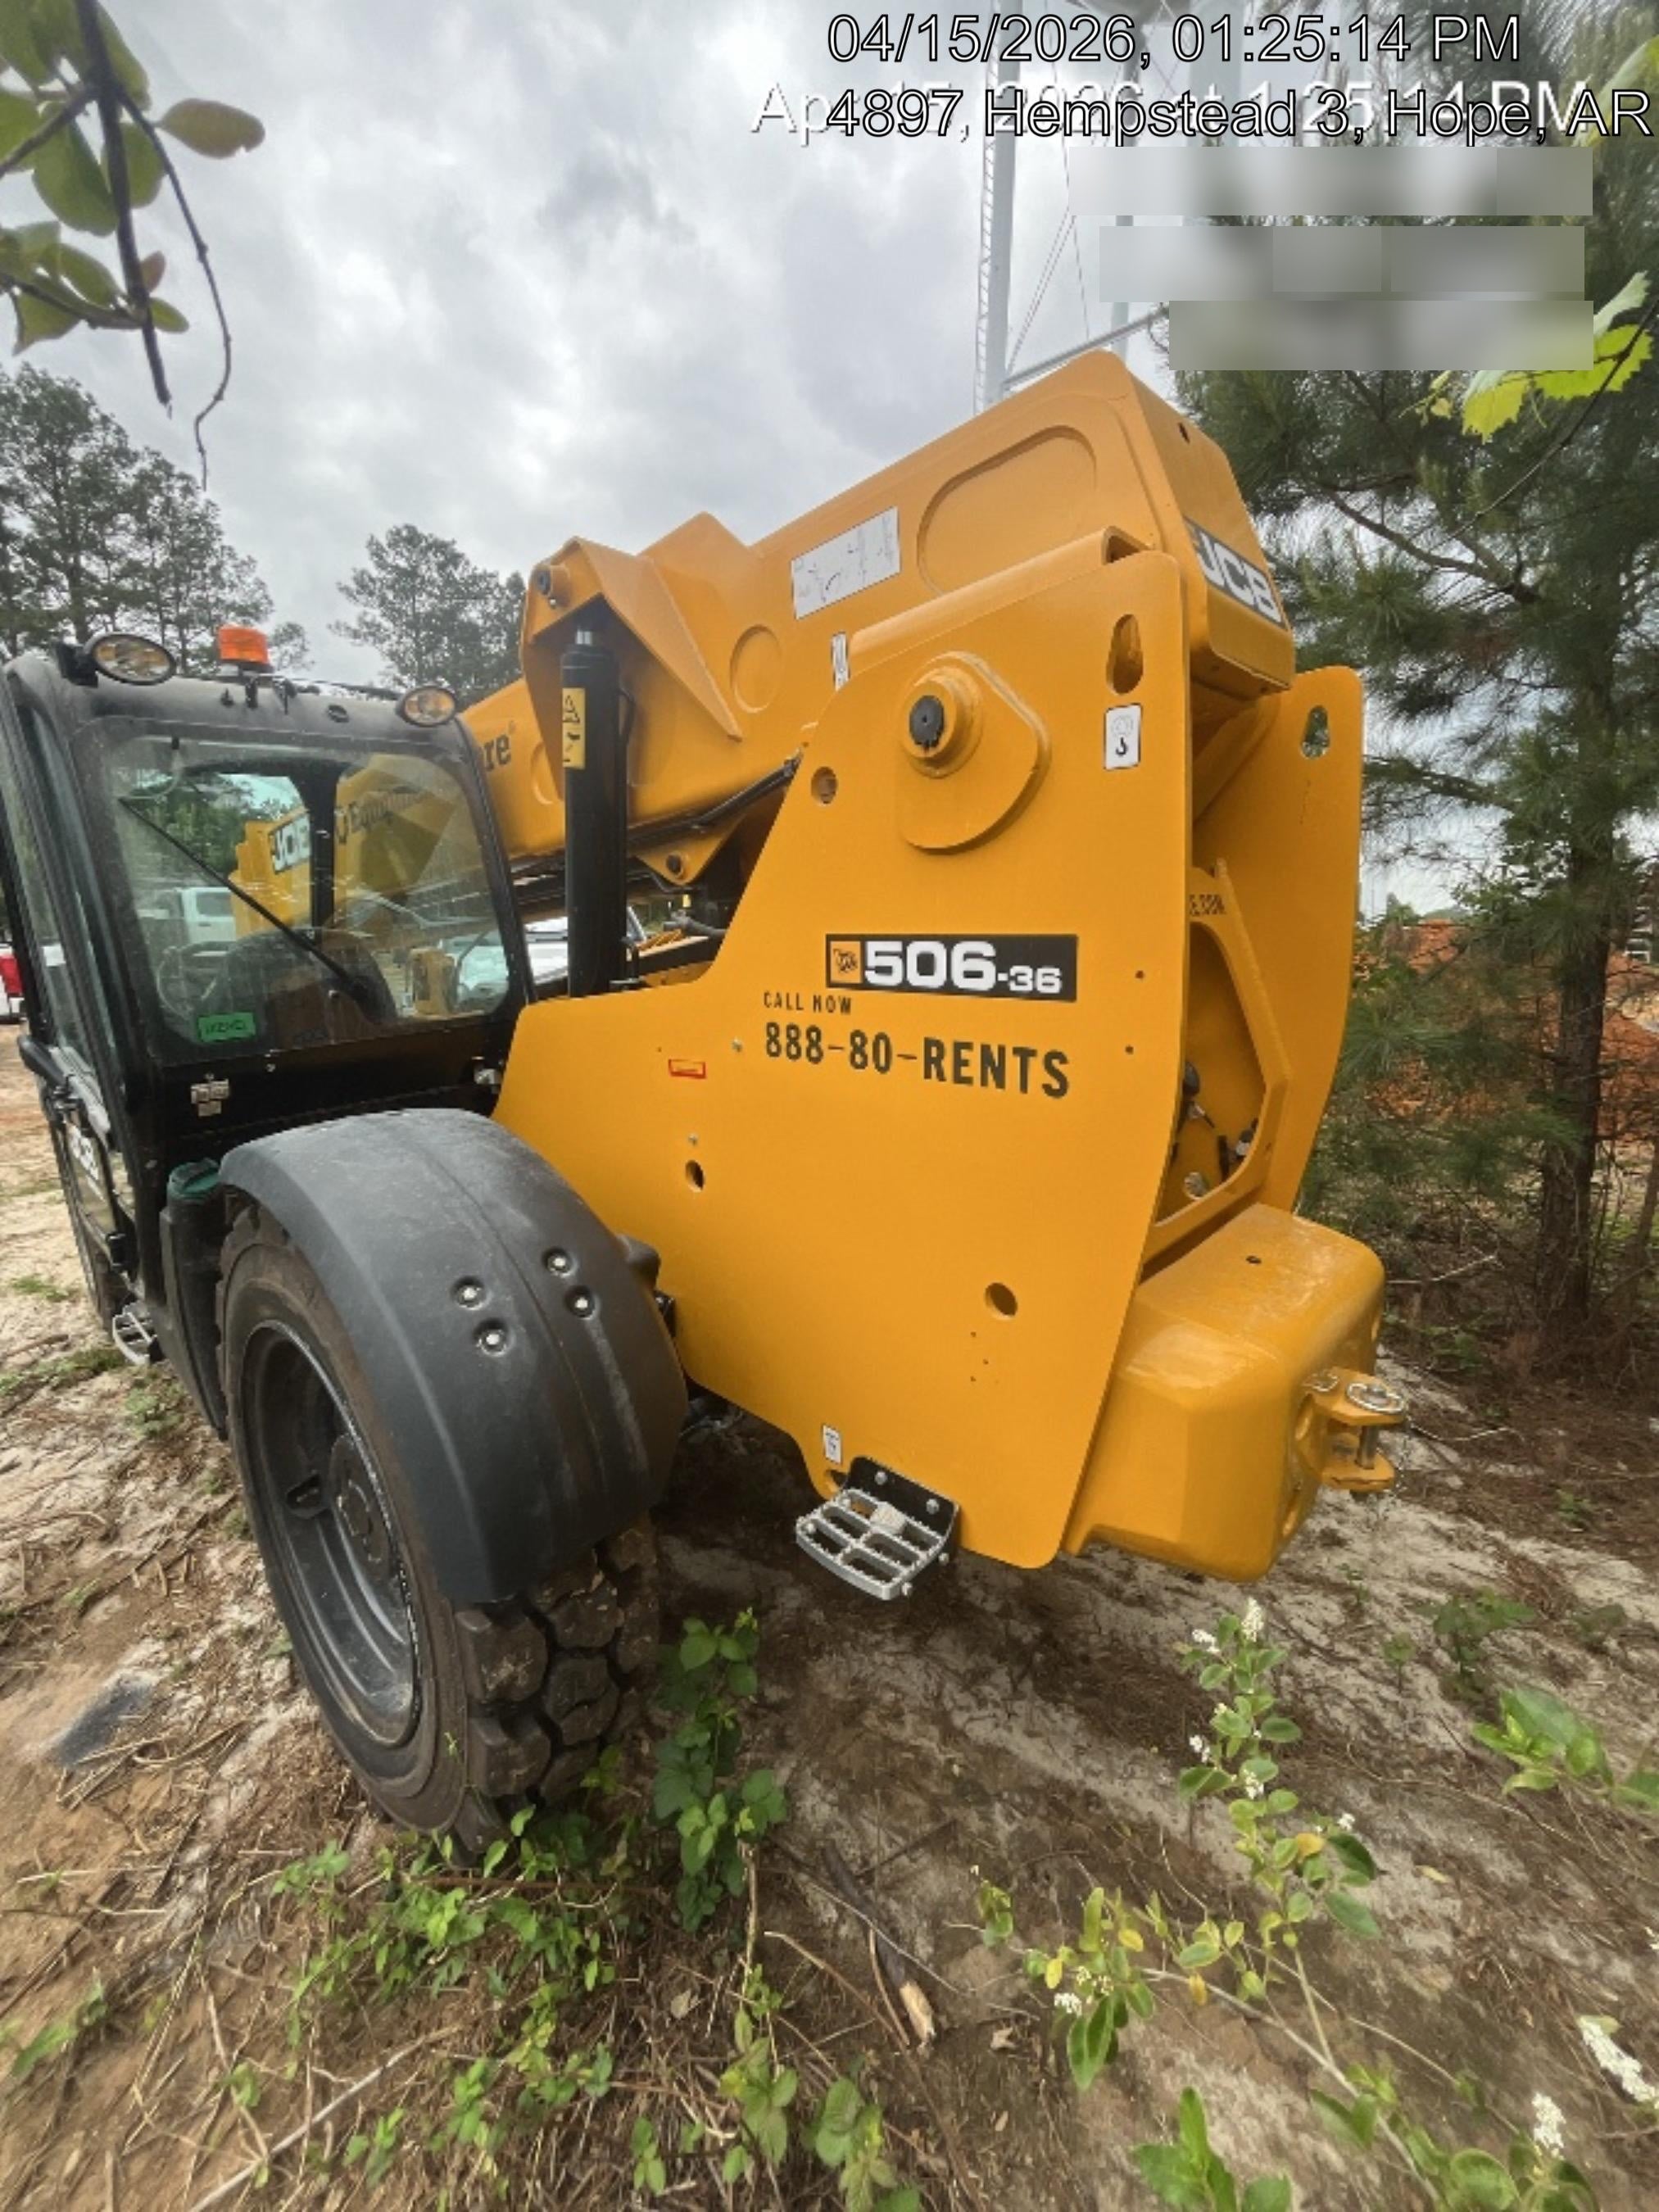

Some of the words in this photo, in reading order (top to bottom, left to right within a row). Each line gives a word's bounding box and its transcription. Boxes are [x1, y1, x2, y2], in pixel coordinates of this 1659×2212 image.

[1196, 532, 1282, 623] JCB
[864, 940, 1063, 994] 506-36
[763, 990, 804, 1011] CALL
[813, 995, 852, 1015] NOW
[765, 1021, 1070, 1099] 888-80-RENTS
